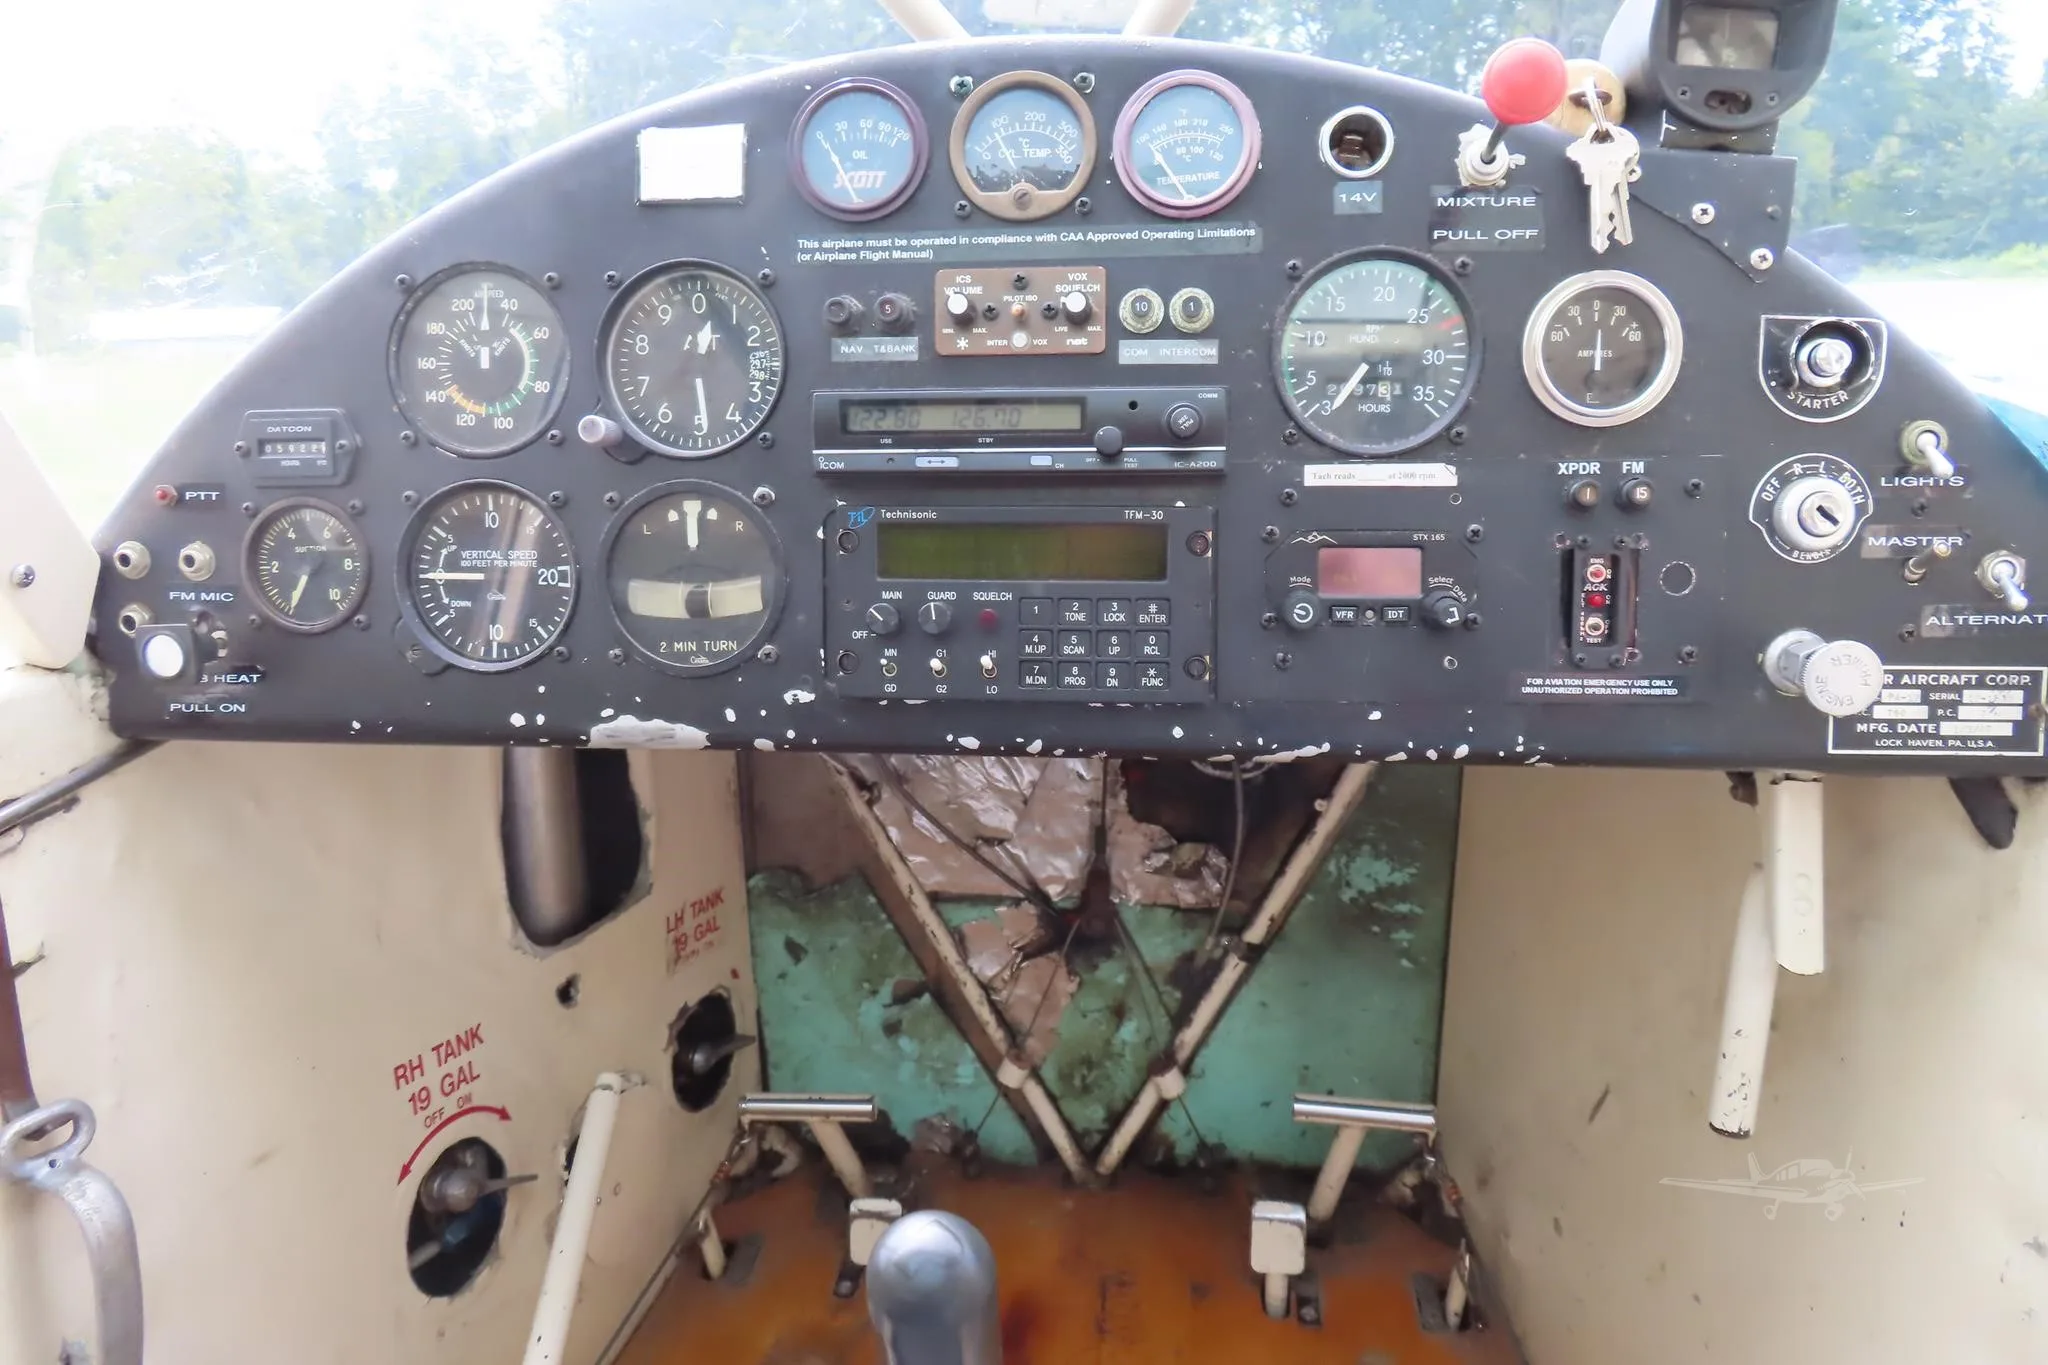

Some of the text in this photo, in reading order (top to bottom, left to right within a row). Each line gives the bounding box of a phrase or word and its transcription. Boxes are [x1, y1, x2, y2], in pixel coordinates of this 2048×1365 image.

[992, 115, 1009, 128] 100
[1025, 111, 1046, 121] 200
[835, 121, 847, 132] 30
[860, 119, 873, 128] 60
[1058, 121, 1078, 137] 300
[893, 126, 910, 141] 120
[852, 150, 868, 159] OIL
[1157, 171, 1220, 186] TEMPERATURE
[1339, 192, 1377, 205] 14V
[1437, 194, 1536, 208] MIXTURE
[797, 227, 1256, 251] This airplane must be operated in compliance with CAA Approved Operating Limitations
[1433, 228, 1539, 241] PULL OFF
[797, 249, 934, 262] (or Airplane Flight Manual)
[956, 275, 971, 283] ICS
[1374, 286, 1395, 302] 20
[452, 299, 474, 311] 200
[501, 299, 518, 310] 40
[1135, 302, 1148, 311] 10
[1328, 297, 1345, 313] 15
[1407, 308, 1429, 324] 25
[1568, 306, 1580, 316] 30
[1614, 306, 1626, 316] 30
[427, 323, 445, 335] 180
[533, 327, 549, 339] 60
[1306, 331, 1325, 345] 10
[1551, 332, 1563, 342] 60
[1629, 331, 1641, 342] 60
[840, 344, 915, 353] NAV T&BANK
[1124, 348, 1216, 356] COM INTERCOM
[1423, 350, 1444, 364] 30
[418, 358, 436, 369] 160
[534, 381, 549, 392] 80
[425, 391, 446, 403] 140
[1413, 386, 1435, 401] 35
[1787, 390, 1848, 409] STARTER
[1358, 404, 1390, 413] HOURS
[457, 414, 475, 426] 120
[494, 417, 513, 429] 100
[1558, 462, 1600, 475] XPDR
[1622, 462, 1645, 474] FM
[1334, 472, 1355, 480] reads
[1881, 476, 1964, 487] LIGHTS
[1637, 487, 1647, 499] 15
[1761, 476, 1781, 502] OFF
[1838, 471, 1866, 505] BOTH
[185, 491, 220, 501] PTT
[881, 510, 937, 519] Technisonic
[1124, 510, 1164, 520] TFM-30
[485, 512, 499, 529] 10
[1868, 536, 1963, 546] MASTER
[461, 550, 537, 560] VERTICAL SPEED
[538, 568, 558, 585] 20
[1584, 583, 1608, 591] ACK
[169, 591, 234, 601] FM MIC
[329, 588, 340, 600] 10
[882, 591, 902, 599] MAIN
[927, 592, 956, 600] GUARD
[973, 592, 1012, 600] SQUELCH
[1453, 586, 1467, 603] Data
[1065, 613, 1086, 621] TONE
[1104, 613, 1126, 622] LOCK
[1139, 615, 1166, 623] ENTER
[1335, 611, 1353, 619] VFR
[1388, 610, 1404, 618] IDT
[1926, 614, 2048, 625] ALTERNAT
[489, 624, 504, 640] 10
[852, 631, 868, 639] OFF
[674, 641, 737, 651] MIN TURN
[1025, 645, 1046, 653] M.UP
[1063, 646, 1085, 654] SCAN
[1109, 646, 1120, 655] UP
[1144, 646, 1160, 655] RCL
[885, 649, 897, 657] MN
[214, 675, 261, 683] HEAT
[1026, 676, 1046, 684] M.DN
[1065, 677, 1086, 686] PROG
[1107, 679, 1118, 687] DN
[1142, 678, 1163, 686] FUNC
[1901, 674, 1979, 685] AIRCRAFT
[1985, 674, 2032, 685] CORP.
[885, 684, 897, 692] GD
[936, 685, 947, 693] G2
[987, 686, 997, 694] LO
[170, 703, 245, 712] PULL ON
[1857, 723, 1937, 733] MFG. DATE
[667, 888, 724, 933] LH TANK
[694, 915, 720, 941] GAL
[394, 1023, 484, 1090] RH TANK
[408, 1061, 480, 1116] 19 GAL
[424, 1107, 445, 1129] OFF
